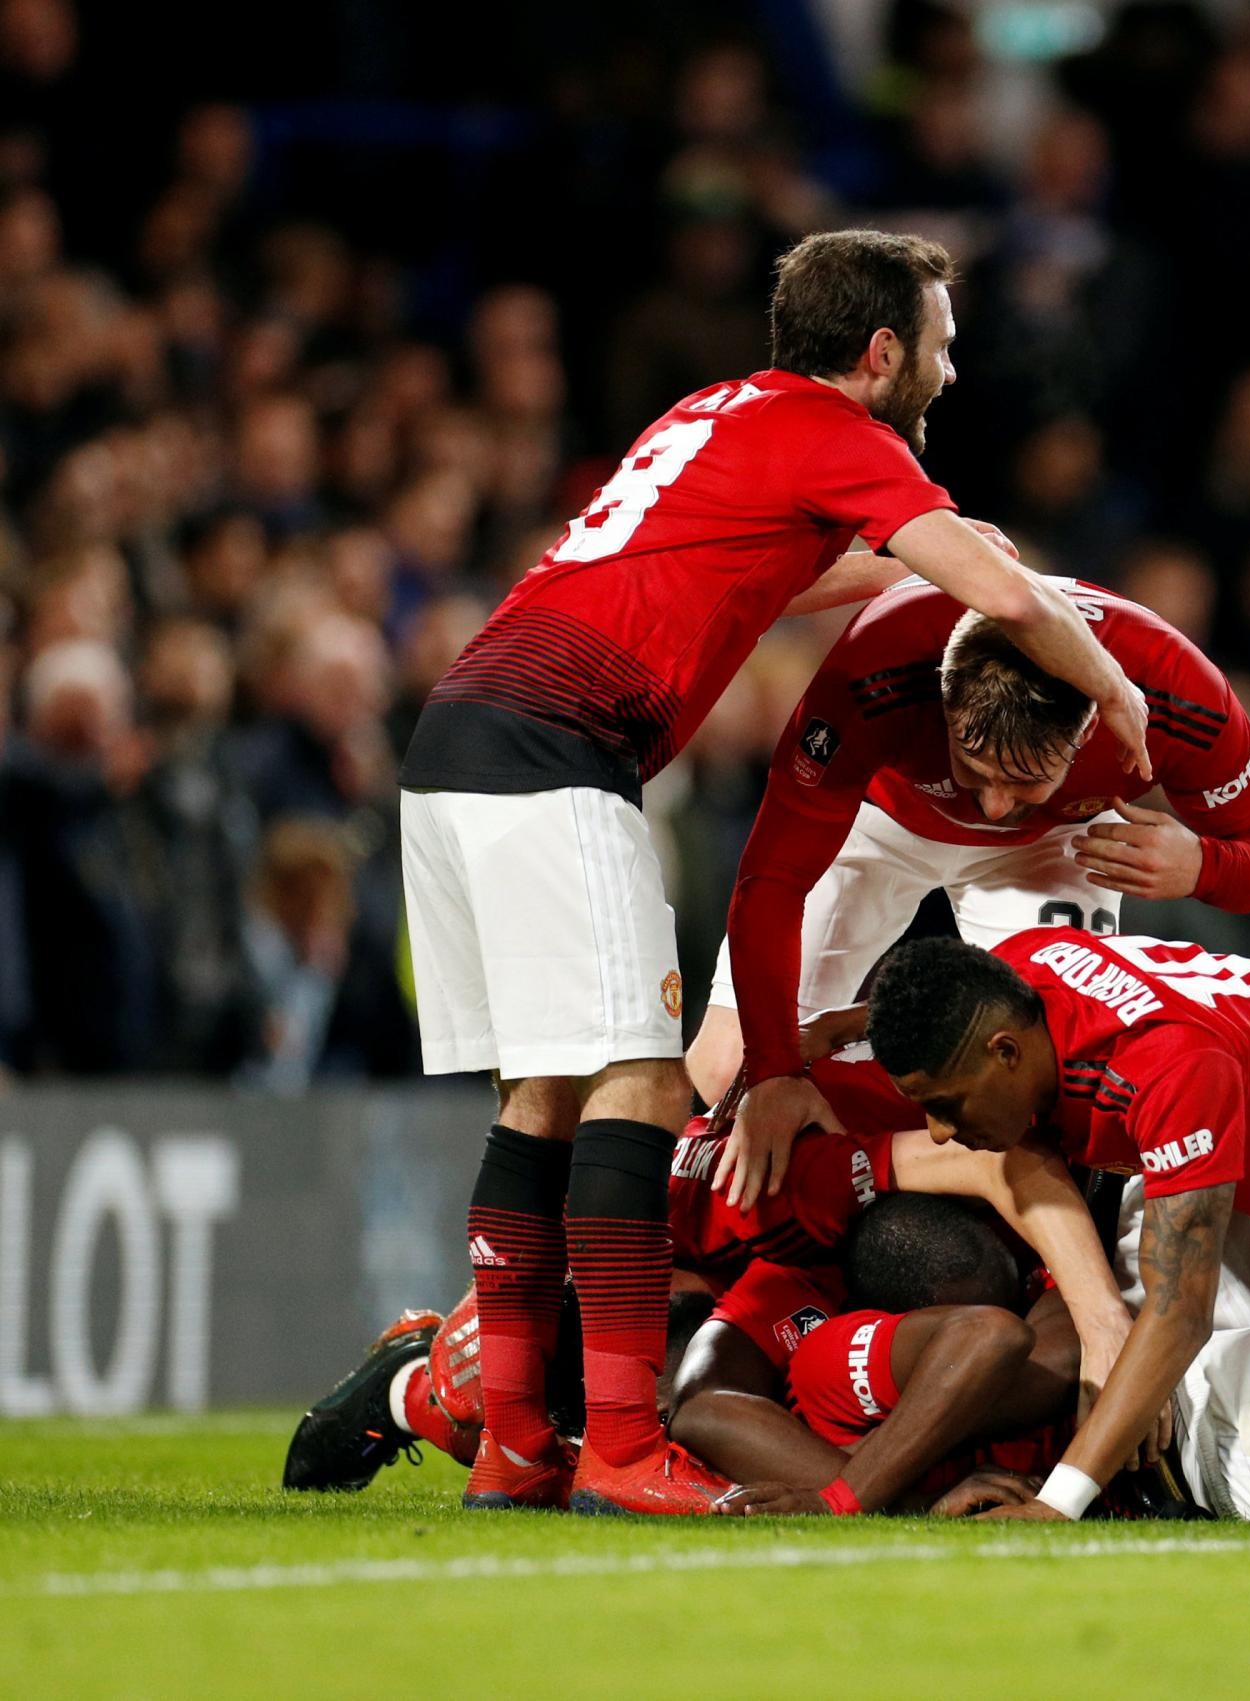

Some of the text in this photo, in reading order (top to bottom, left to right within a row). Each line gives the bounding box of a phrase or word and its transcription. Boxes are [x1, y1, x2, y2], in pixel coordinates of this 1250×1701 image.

[554, 418, 715, 564] 8
[1030, 941, 1164, 1027] RASHFORD
[852, 1150, 876, 1206] HLER
[1140, 1128, 1214, 1173] OHLER
[848, 1319, 882, 1416] KOHLER
